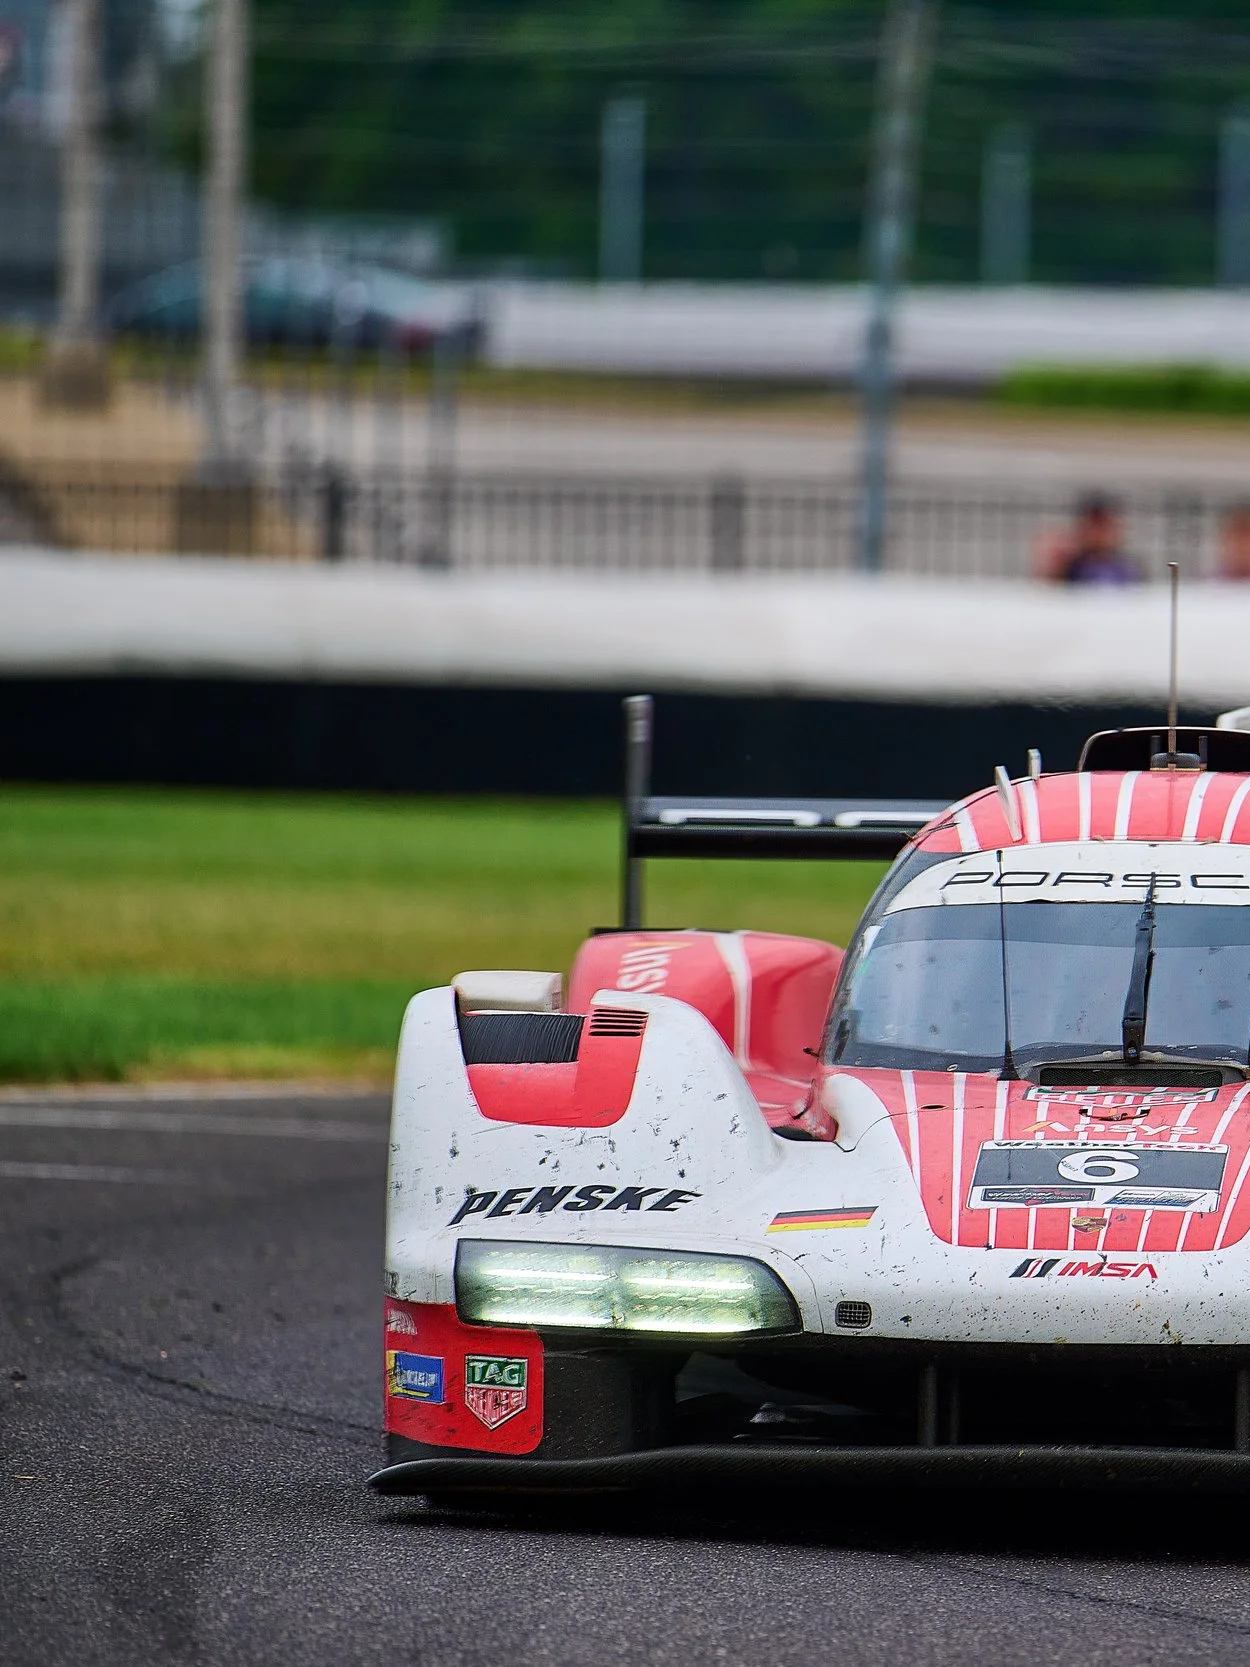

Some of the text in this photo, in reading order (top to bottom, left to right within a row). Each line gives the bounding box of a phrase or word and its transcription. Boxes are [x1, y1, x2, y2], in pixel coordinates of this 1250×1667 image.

[996, 1140, 1218, 1152] WeatherTech
[1057, 1150, 1141, 1184] 6
[446, 1184, 704, 1227] PENSKE
[1057, 1261, 1158, 1279] IMSA
[469, 1362, 521, 1385] TAG
